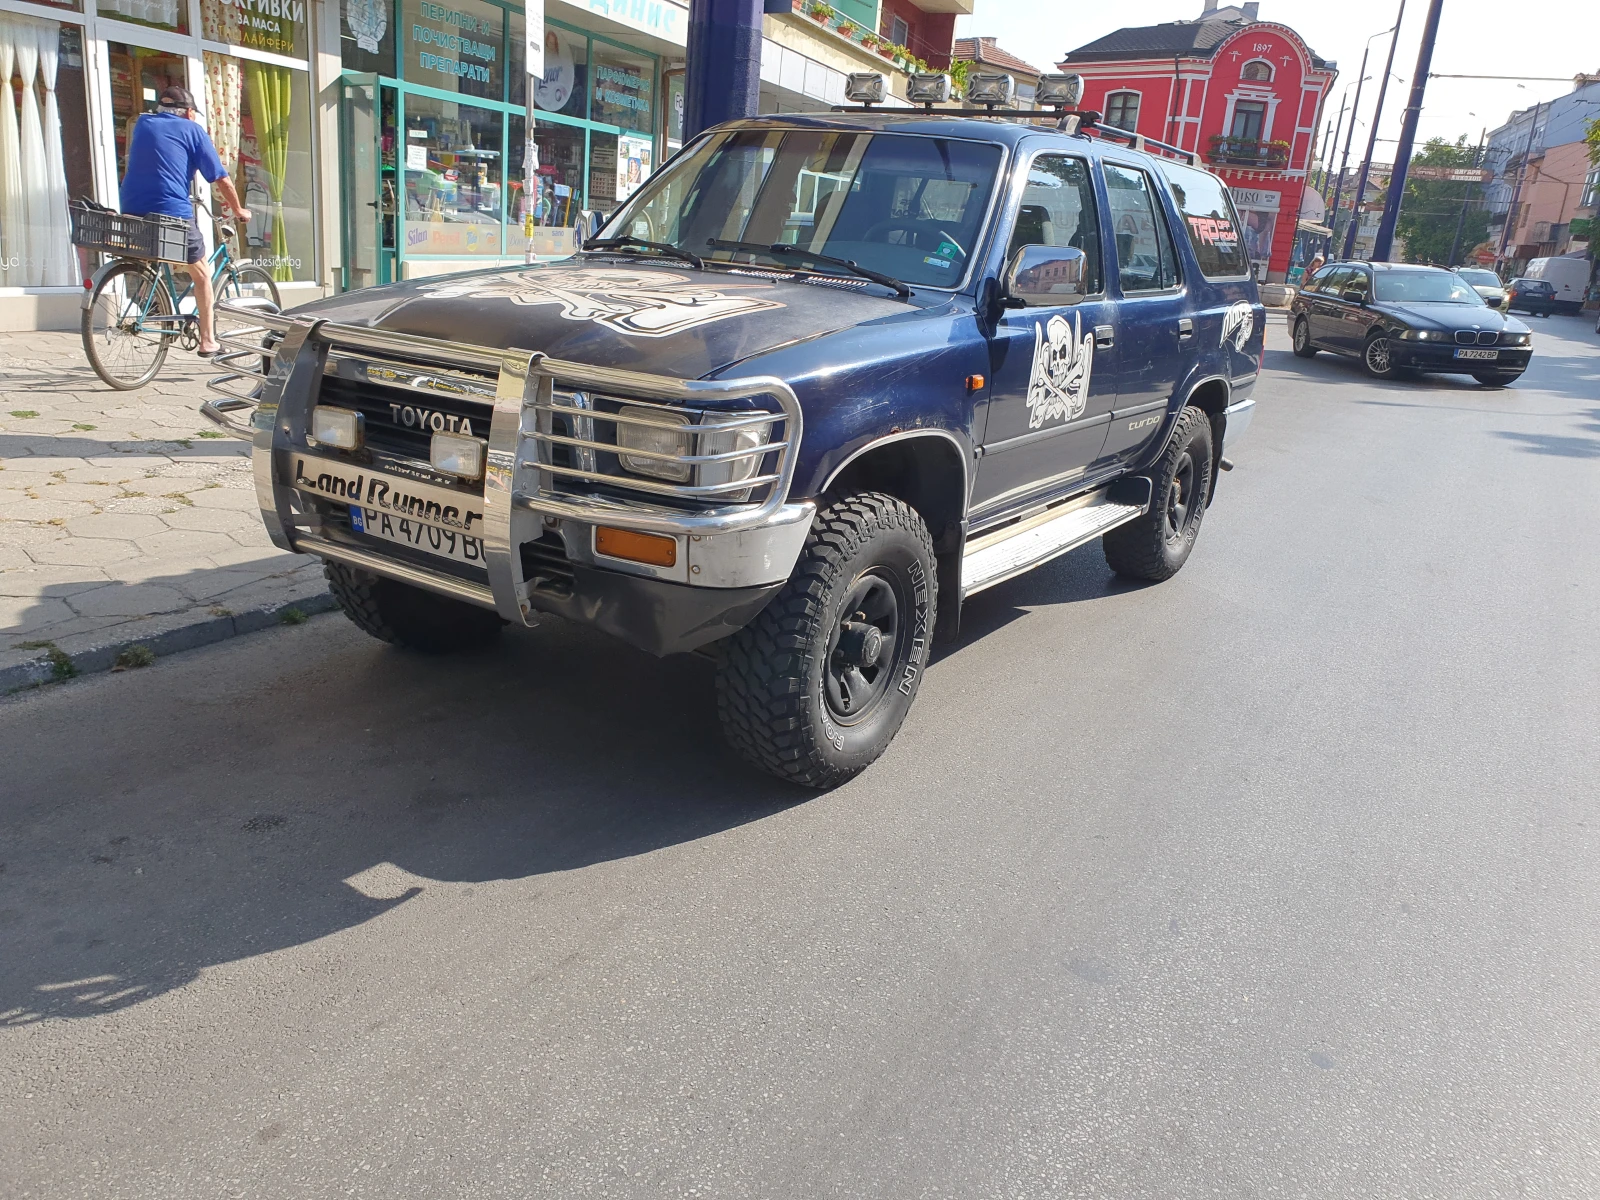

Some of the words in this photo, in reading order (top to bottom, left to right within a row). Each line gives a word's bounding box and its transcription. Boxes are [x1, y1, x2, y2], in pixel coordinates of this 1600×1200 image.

[237, 12, 250, 27] ЗА
[252, 16, 281, 34] МАСА
[421, 1, 477, 32] ПЕРИЛНИ
[481, 19, 490, 36] И
[413, 23, 496, 62] ПОЧИСТВАЩИ
[1252, 42, 1273, 54] 1897
[420, 51, 490, 84] ПРЕПАРАТИ
[407, 227, 428, 247] Silan
[389, 403, 473, 437] TOYOTA
[1128, 415, 1161, 431] turbo
[296, 459, 364, 501] Land
[366, 478, 483, 531] Runner
[352, 515, 363, 527] BG
[898, 559, 929, 696] NEXEN
